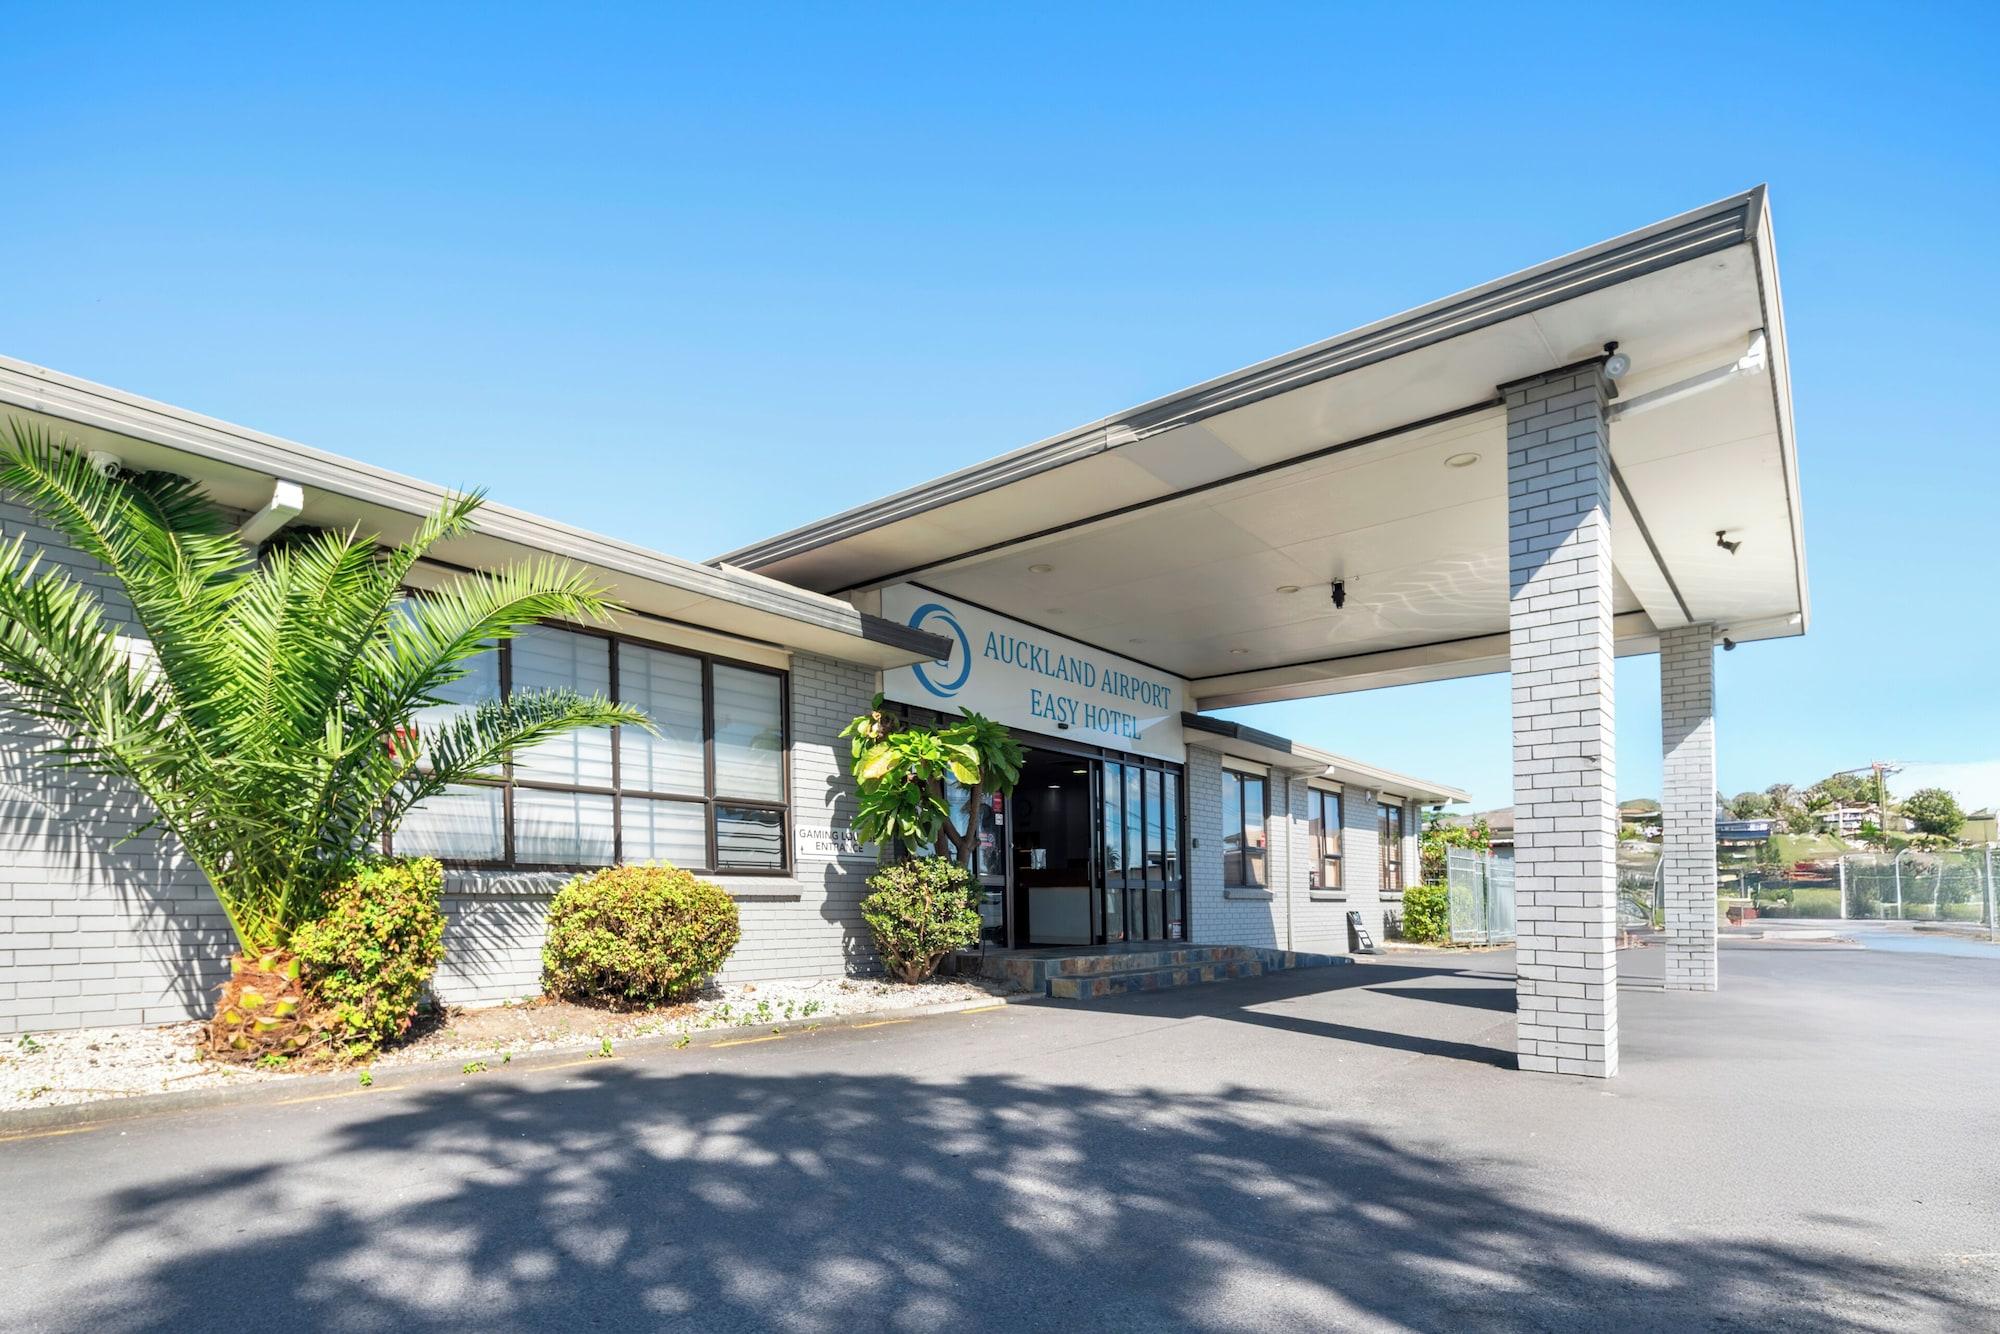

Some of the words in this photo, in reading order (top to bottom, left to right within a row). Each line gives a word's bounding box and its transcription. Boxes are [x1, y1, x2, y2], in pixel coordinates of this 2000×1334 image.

[984, 631, 1096, 688] AUCKLAND
[1101, 669, 1171, 710] AIRPORT
[1031, 688, 1078, 725] EASY
[1084, 703, 1142, 740] HOTEL
[799, 828, 838, 840] GAMING
